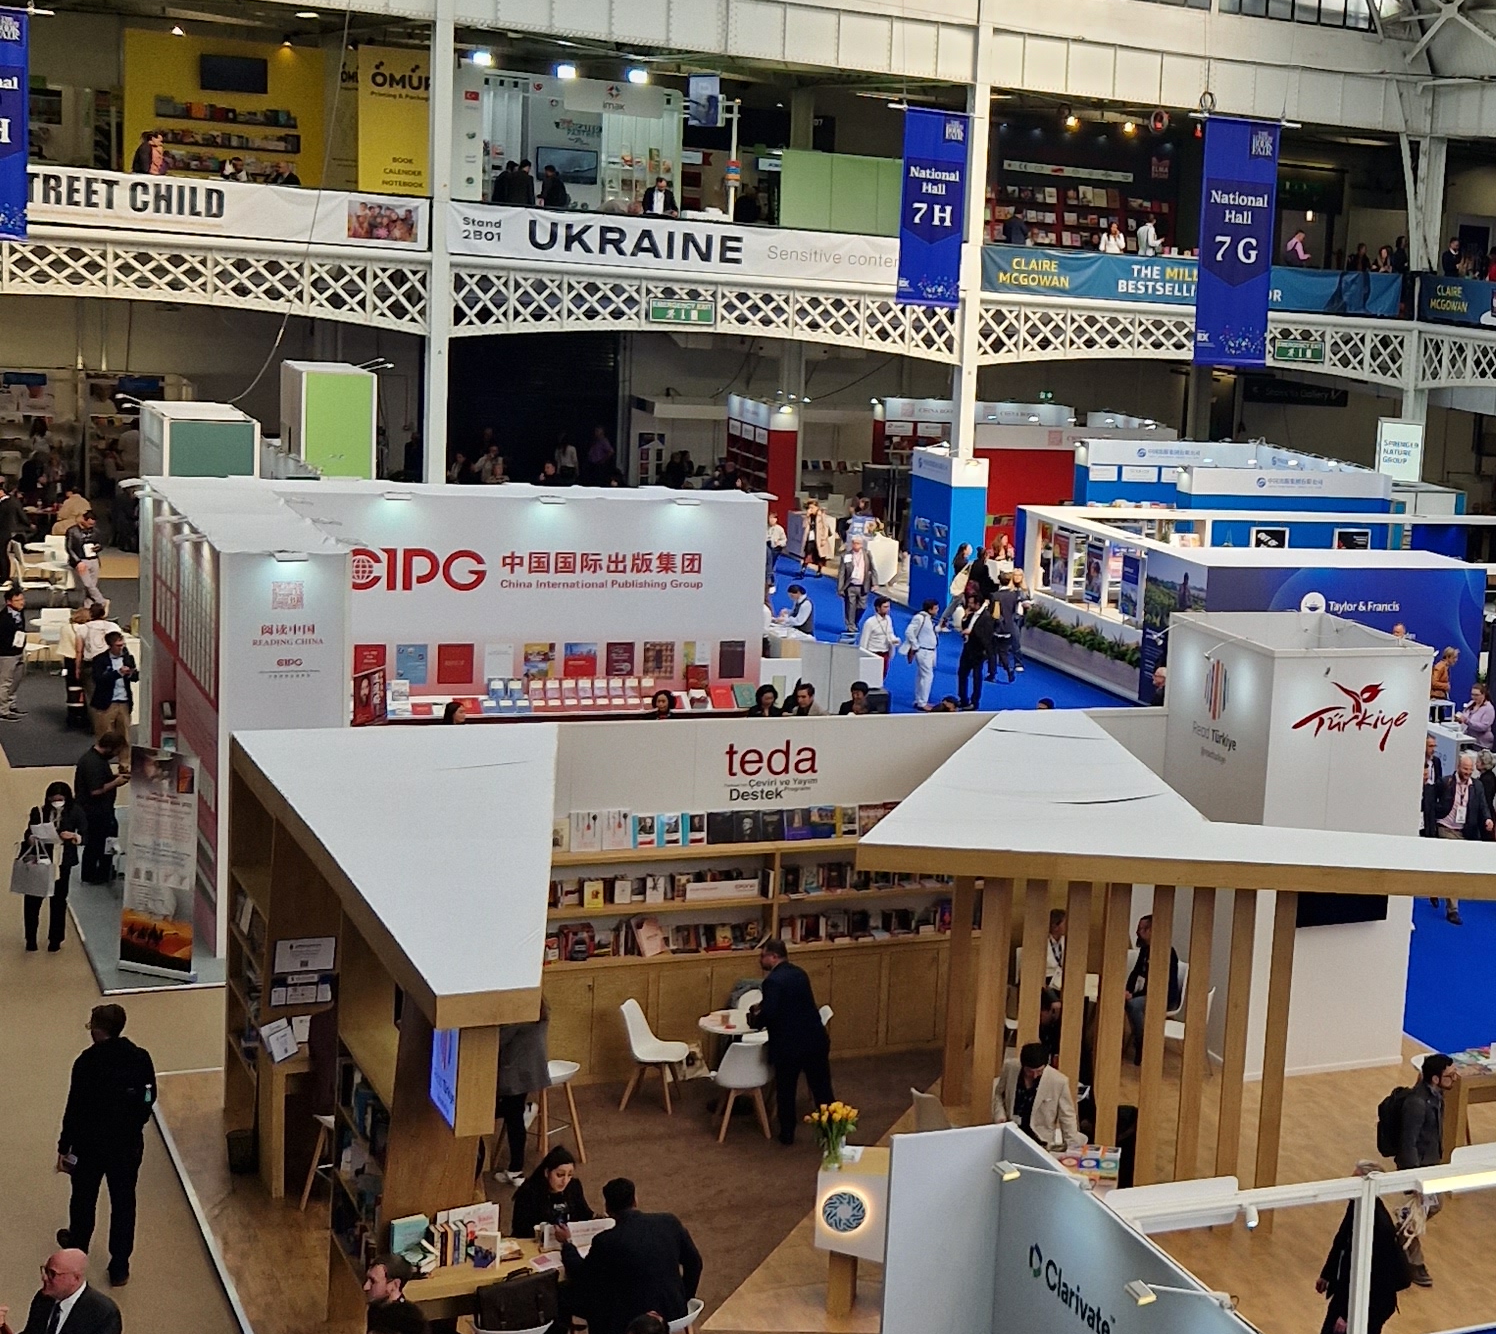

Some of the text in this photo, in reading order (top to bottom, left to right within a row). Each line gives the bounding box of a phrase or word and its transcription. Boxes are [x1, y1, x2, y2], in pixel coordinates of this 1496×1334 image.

[603, 100, 626, 111] imax
[392, 156, 413, 165] BOOK
[909, 165, 960, 183] National
[382, 179, 424, 189] NOTEBOOK
[922, 181, 946, 196] Hall
[28, 172, 225, 219] TREET CHILD
[1210, 189, 1269, 209] National
[463, 216, 502, 229] Stand
[1224, 209, 1252, 225] Hall
[462, 229, 501, 242] 2B01
[528, 218, 744, 266] UKRAINE
[767, 245, 842, 265] Sensitive
[1012, 257, 1059, 273] CLAIRE
[1132, 265, 1199, 281] THE MILL
[999, 271, 1069, 289] MCGOWAN
[1118, 279, 1196, 298] BESTSELLI
[1436, 283, 1463, 298] CLAIRE
[1429, 297, 1468, 314] MCGOWAN
[1383, 447, 1412, 457] NATURE
[501, 551, 703, 575] 中国国际出版集团
[500, 578, 704, 591] China International Publishing Group
[1328, 600, 1401, 615] Taylor & Francis
[261, 623, 316, 636] 阅读中国
[252, 637, 324, 646] READING CHINA
[276, 658, 303, 667] CIPG
[1291, 697, 1409, 753] Türkiye
[1211, 728, 1237, 752] Türkiye
[724, 739, 819, 778] teda
[748, 778, 777, 789] Çeviri
[779, 779, 791, 787] ve
[729, 787, 784, 803] Destek
